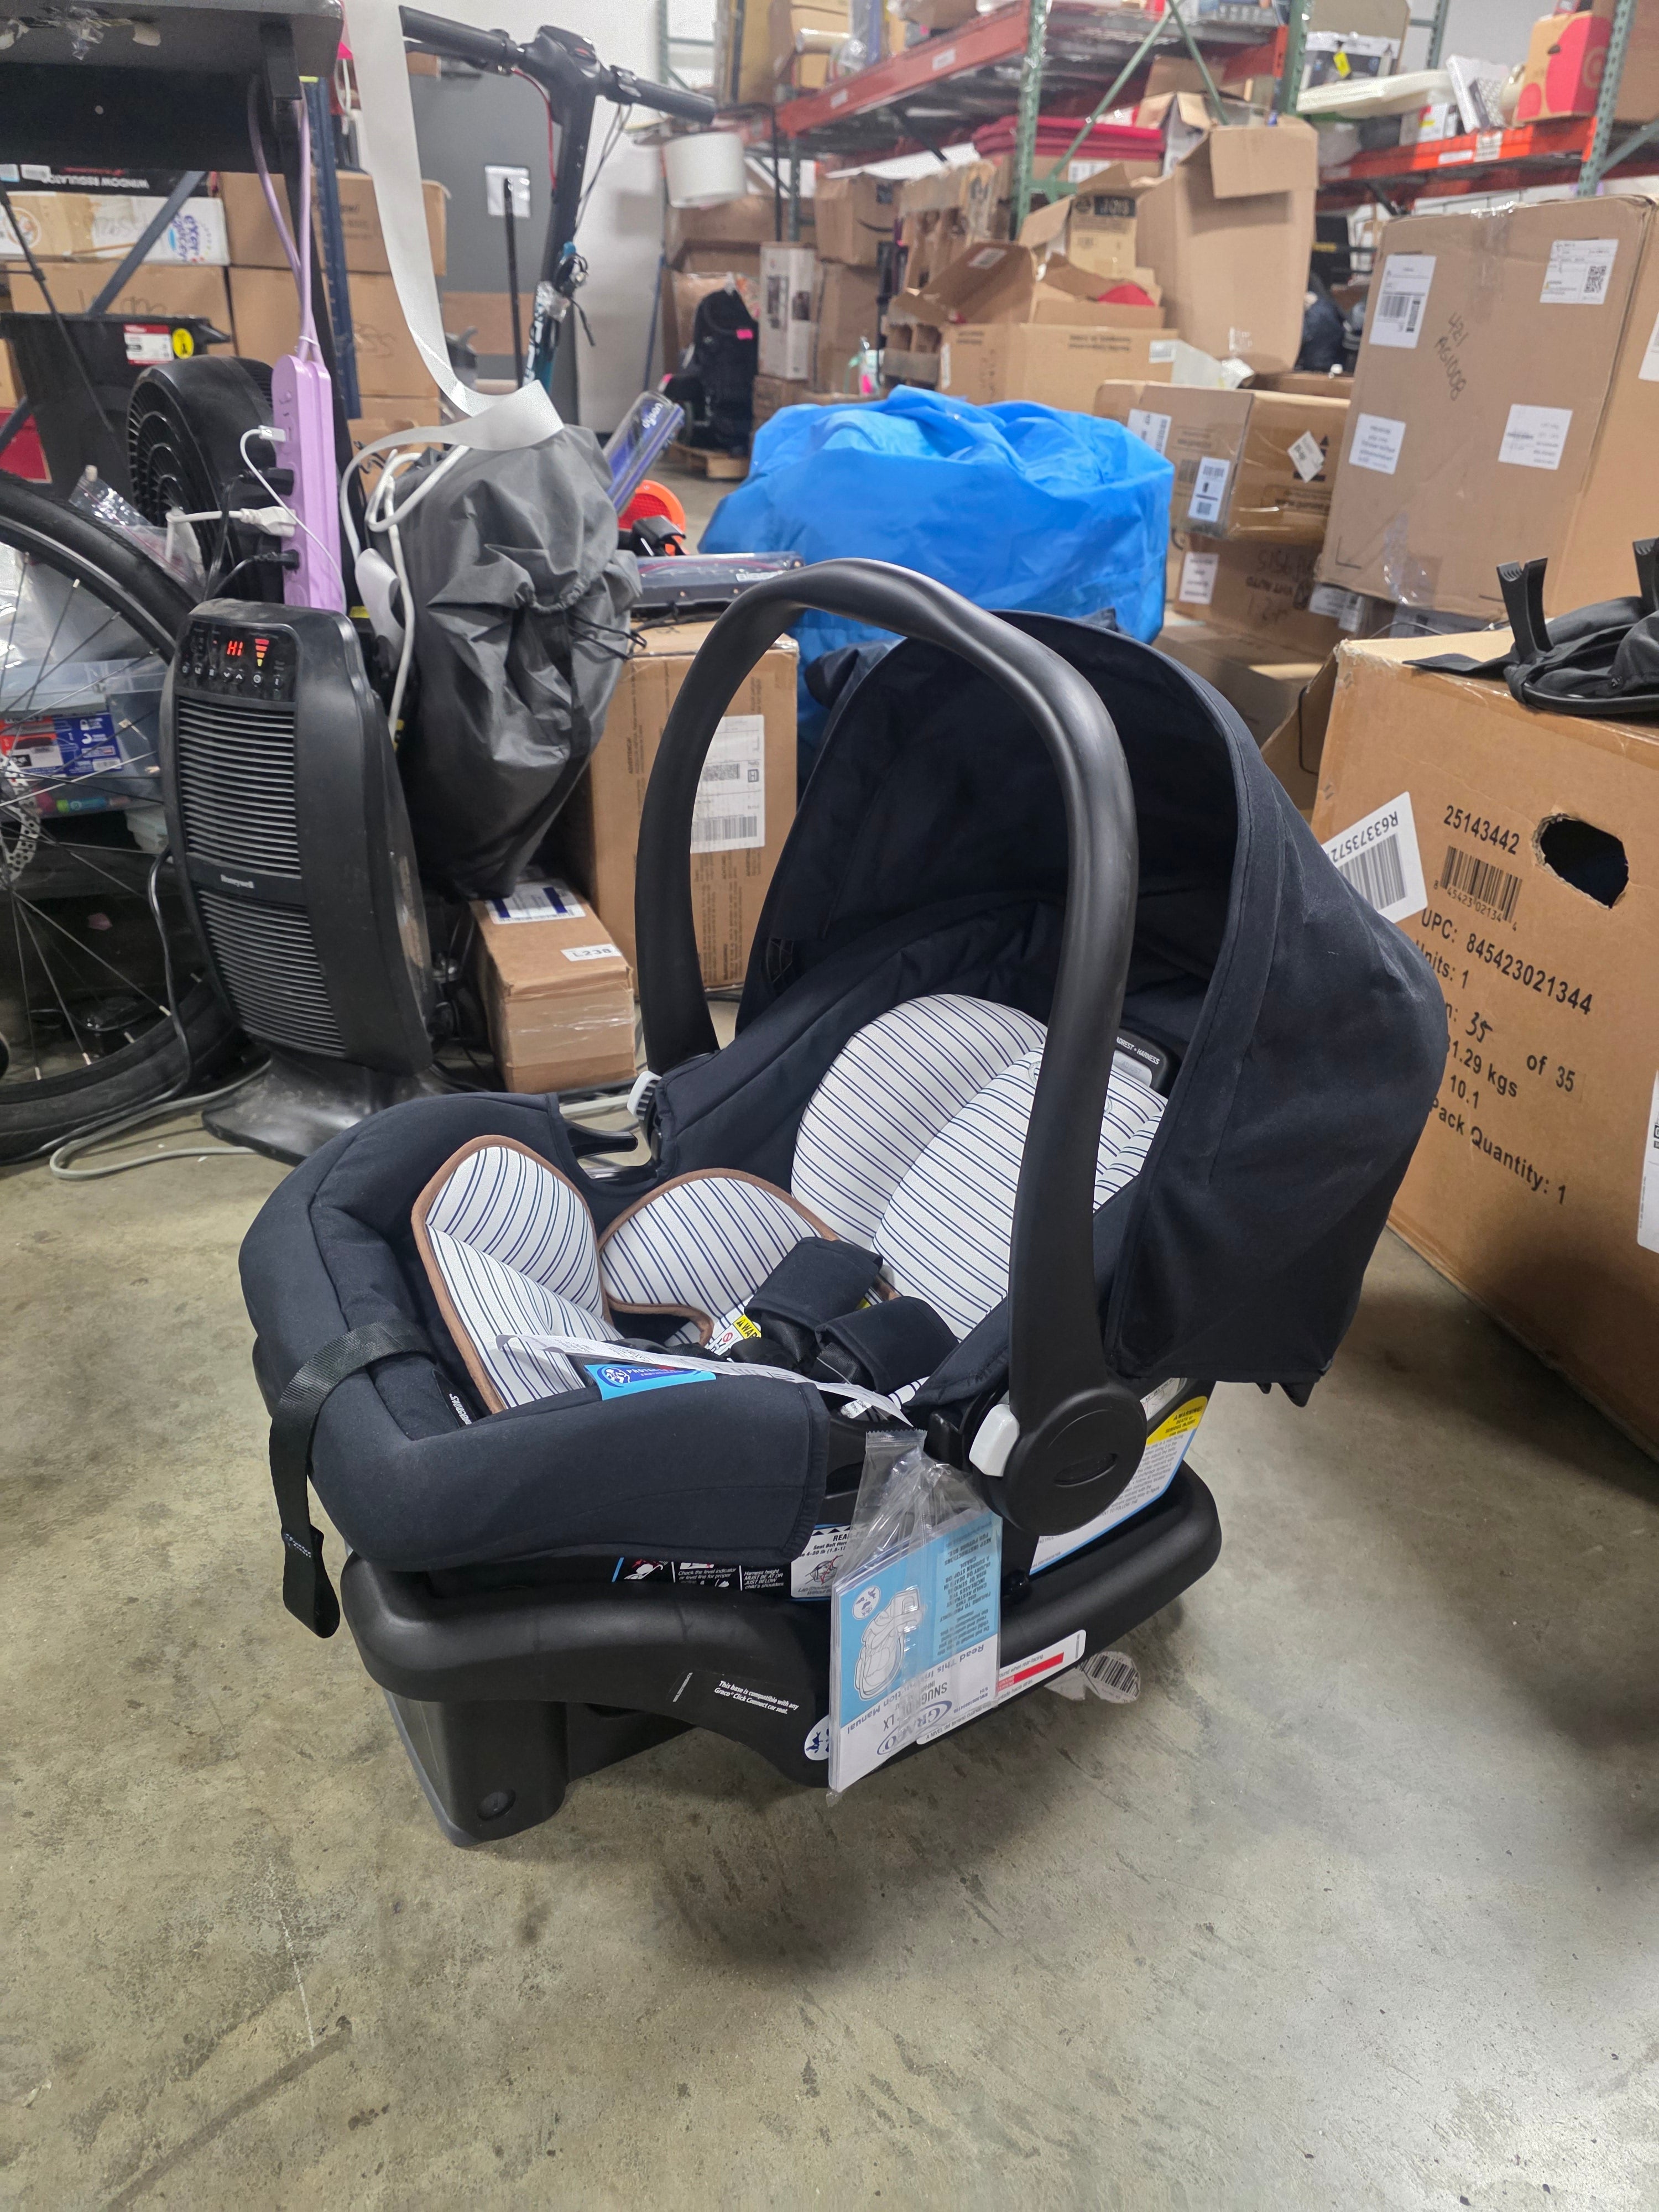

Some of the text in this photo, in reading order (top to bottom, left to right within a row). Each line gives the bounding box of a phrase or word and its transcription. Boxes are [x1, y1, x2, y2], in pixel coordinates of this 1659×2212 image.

[641, 403, 664, 429] dyson
[1442, 804, 1522, 857] 25143442
[572, 948, 612, 958] L238
[1420, 905, 1593, 1016] UPC: 845423021344
[1462, 970, 1469, 989] 1
[1465, 1011, 1493, 1043] 35
[1116, 1036, 1160, 1065] DREST HARNESS
[1446, 1032, 1519, 1099] 1.29 kgs
[1526, 1053, 1576, 1092] of 35
[1450, 1074, 1480, 1109] 10.1
[1430, 1097, 1566, 1205] Pack Quantity: 1
[940, 1605, 963, 1622] PRORLY
[718, 1681, 731, 1689] This
[730, 1684, 743, 1693] base
[748, 1691, 778, 1703] compatible
[733, 1693, 747, 1702] Click
[747, 1697, 768, 1709] Connect
[847, 1642, 983, 1734] Read This Inuction Manual
[883, 1713, 894, 1731] LX
[931, 1727, 943, 1738] NIVEL
